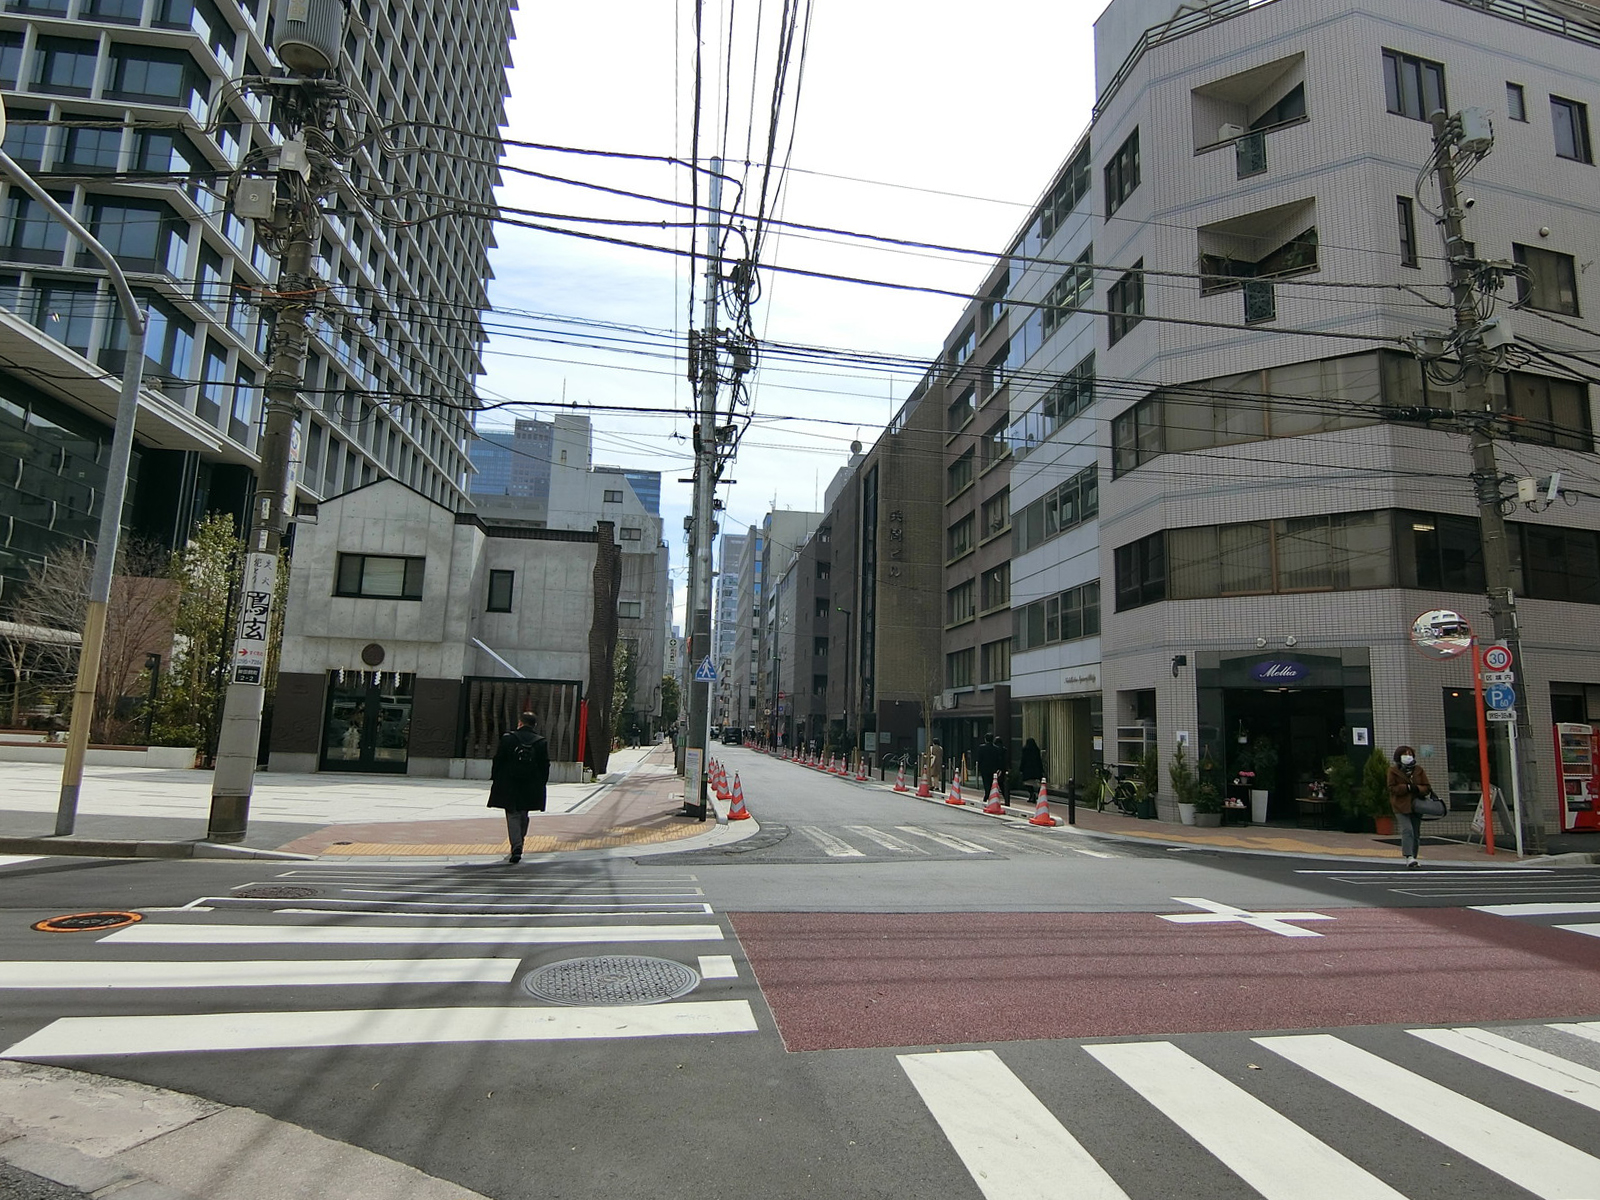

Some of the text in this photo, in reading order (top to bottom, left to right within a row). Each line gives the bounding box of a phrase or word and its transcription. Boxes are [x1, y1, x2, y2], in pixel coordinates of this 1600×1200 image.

[1489, 653, 1506, 665] 30
[1491, 690, 1503, 707] P
[1499, 699, 1509, 707] 60
